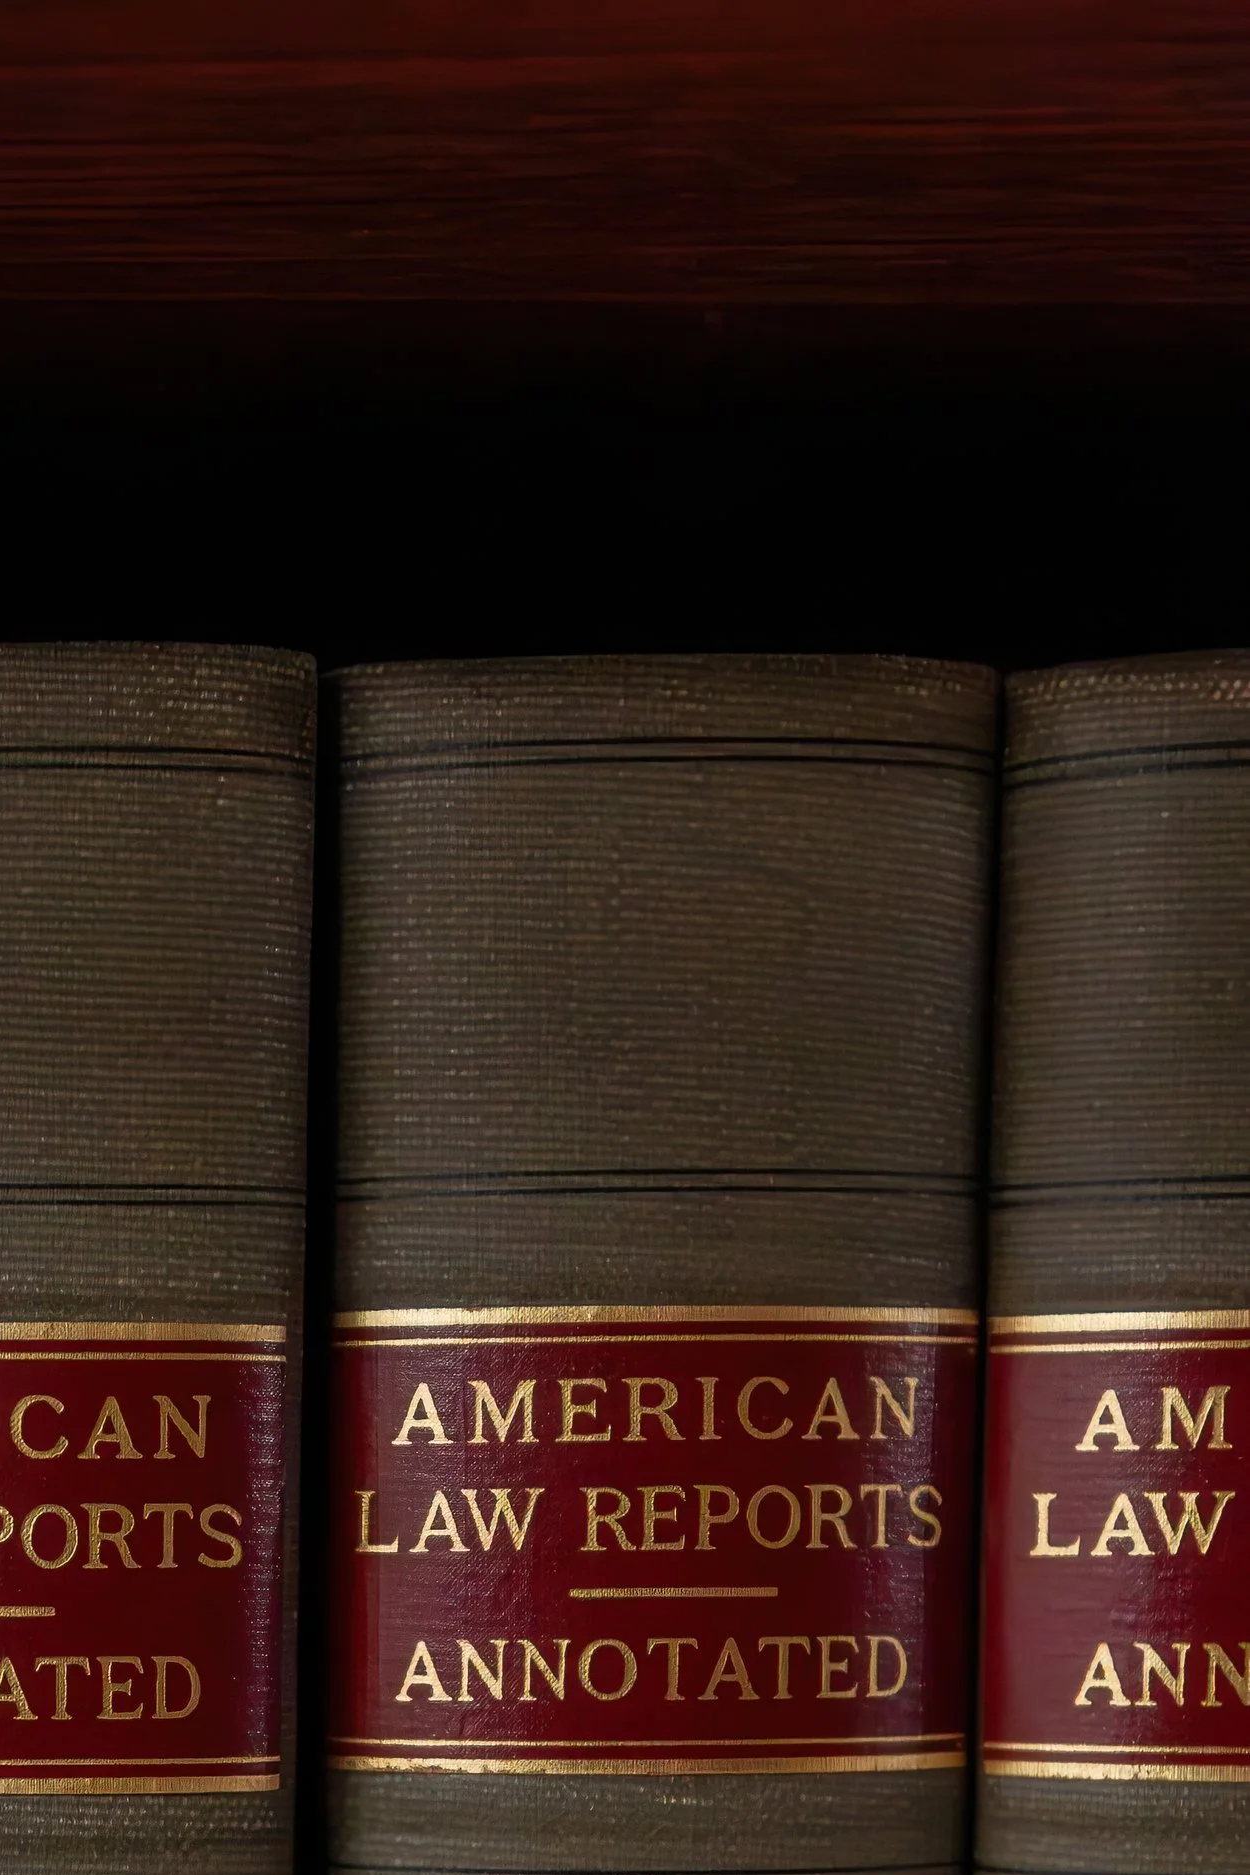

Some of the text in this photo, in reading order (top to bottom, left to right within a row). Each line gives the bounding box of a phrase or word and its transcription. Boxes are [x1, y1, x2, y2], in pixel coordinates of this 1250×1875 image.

[391, 1376, 921, 1446] AMERICAN
[356, 1484, 943, 1554] LAW REPORTS
[1029, 1491, 1236, 1557] LAW
[394, 1635, 908, 1703] ANNOTATED
